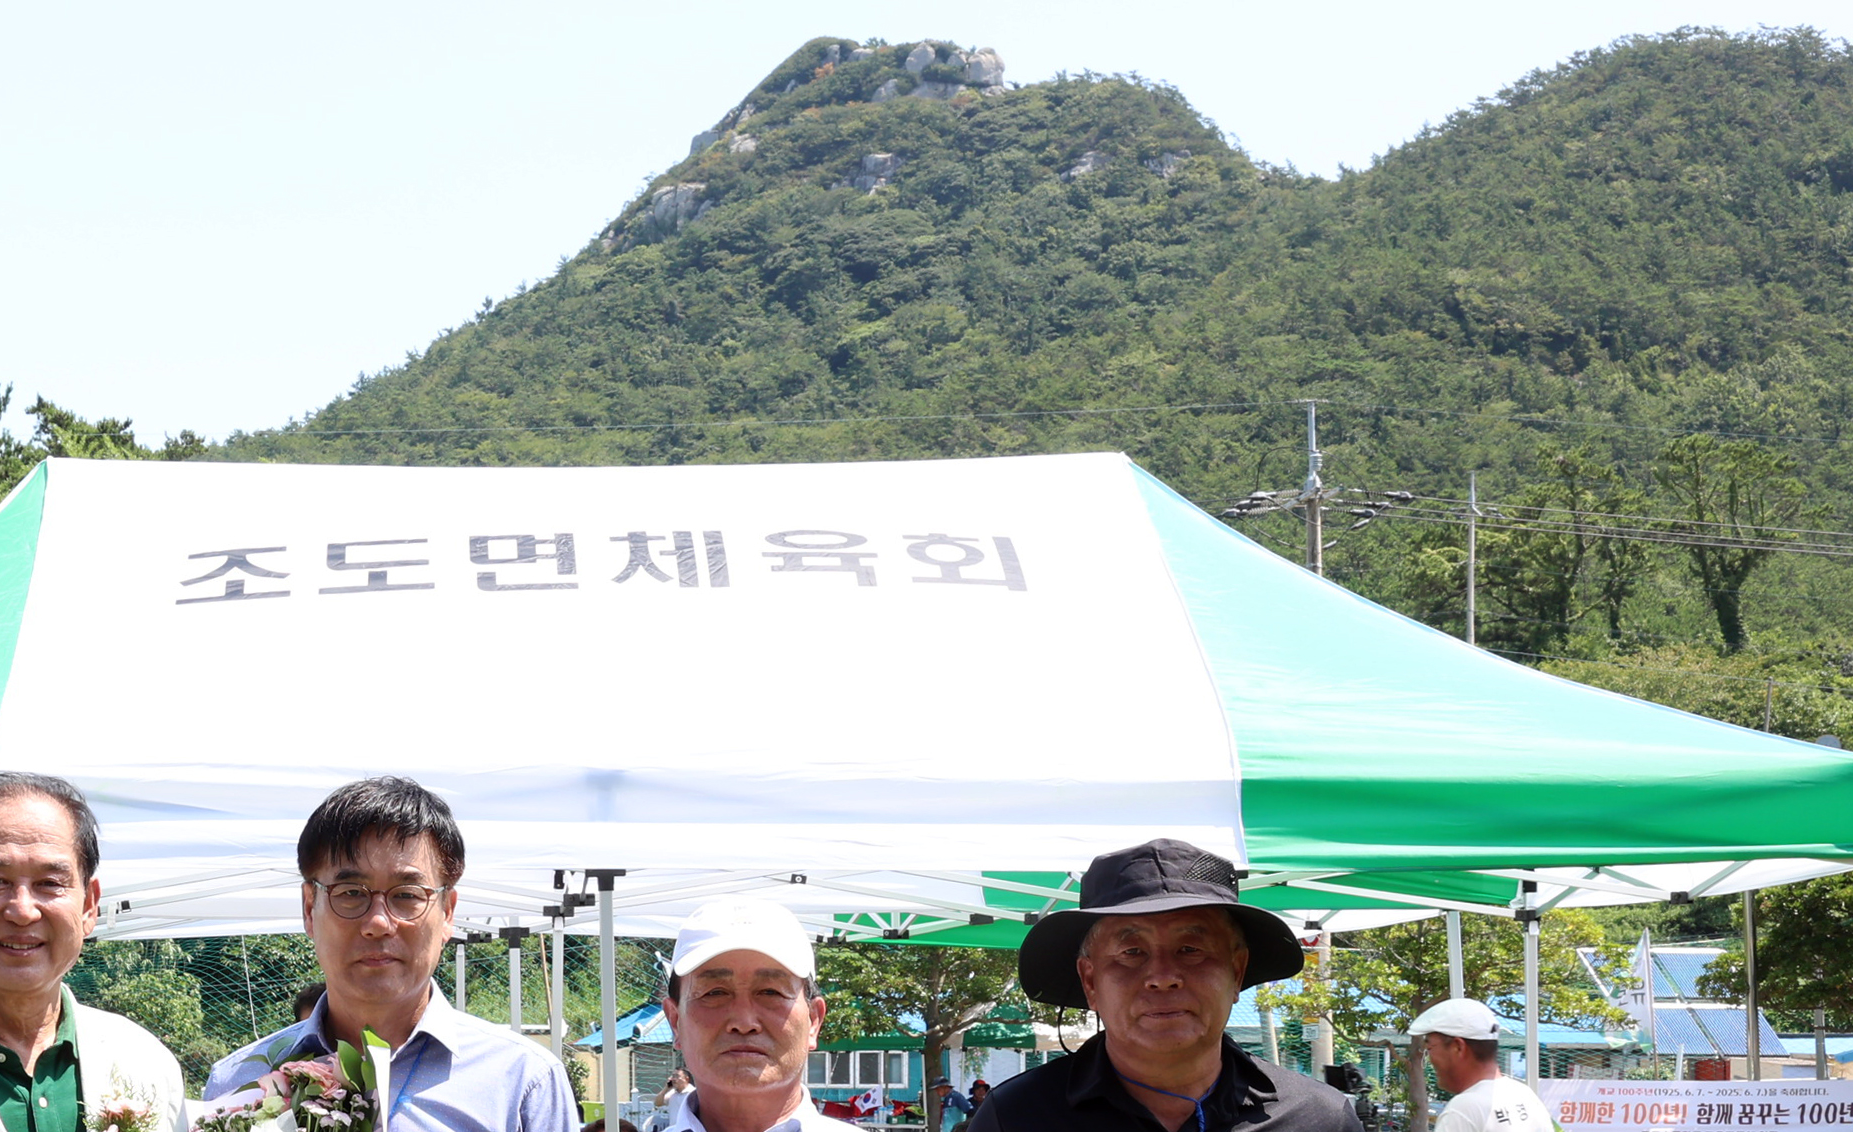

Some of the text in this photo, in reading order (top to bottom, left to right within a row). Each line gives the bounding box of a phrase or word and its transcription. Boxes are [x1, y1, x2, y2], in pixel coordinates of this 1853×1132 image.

[175, 529, 1028, 606] 조도면체육회
[1560, 1101, 1616, 1125] 함께한
[1621, 1102, 1688, 1125] 100년!
[1696, 1102, 1734, 1125] 함께
[1738, 1103, 1791, 1125] 꿈꾸는
